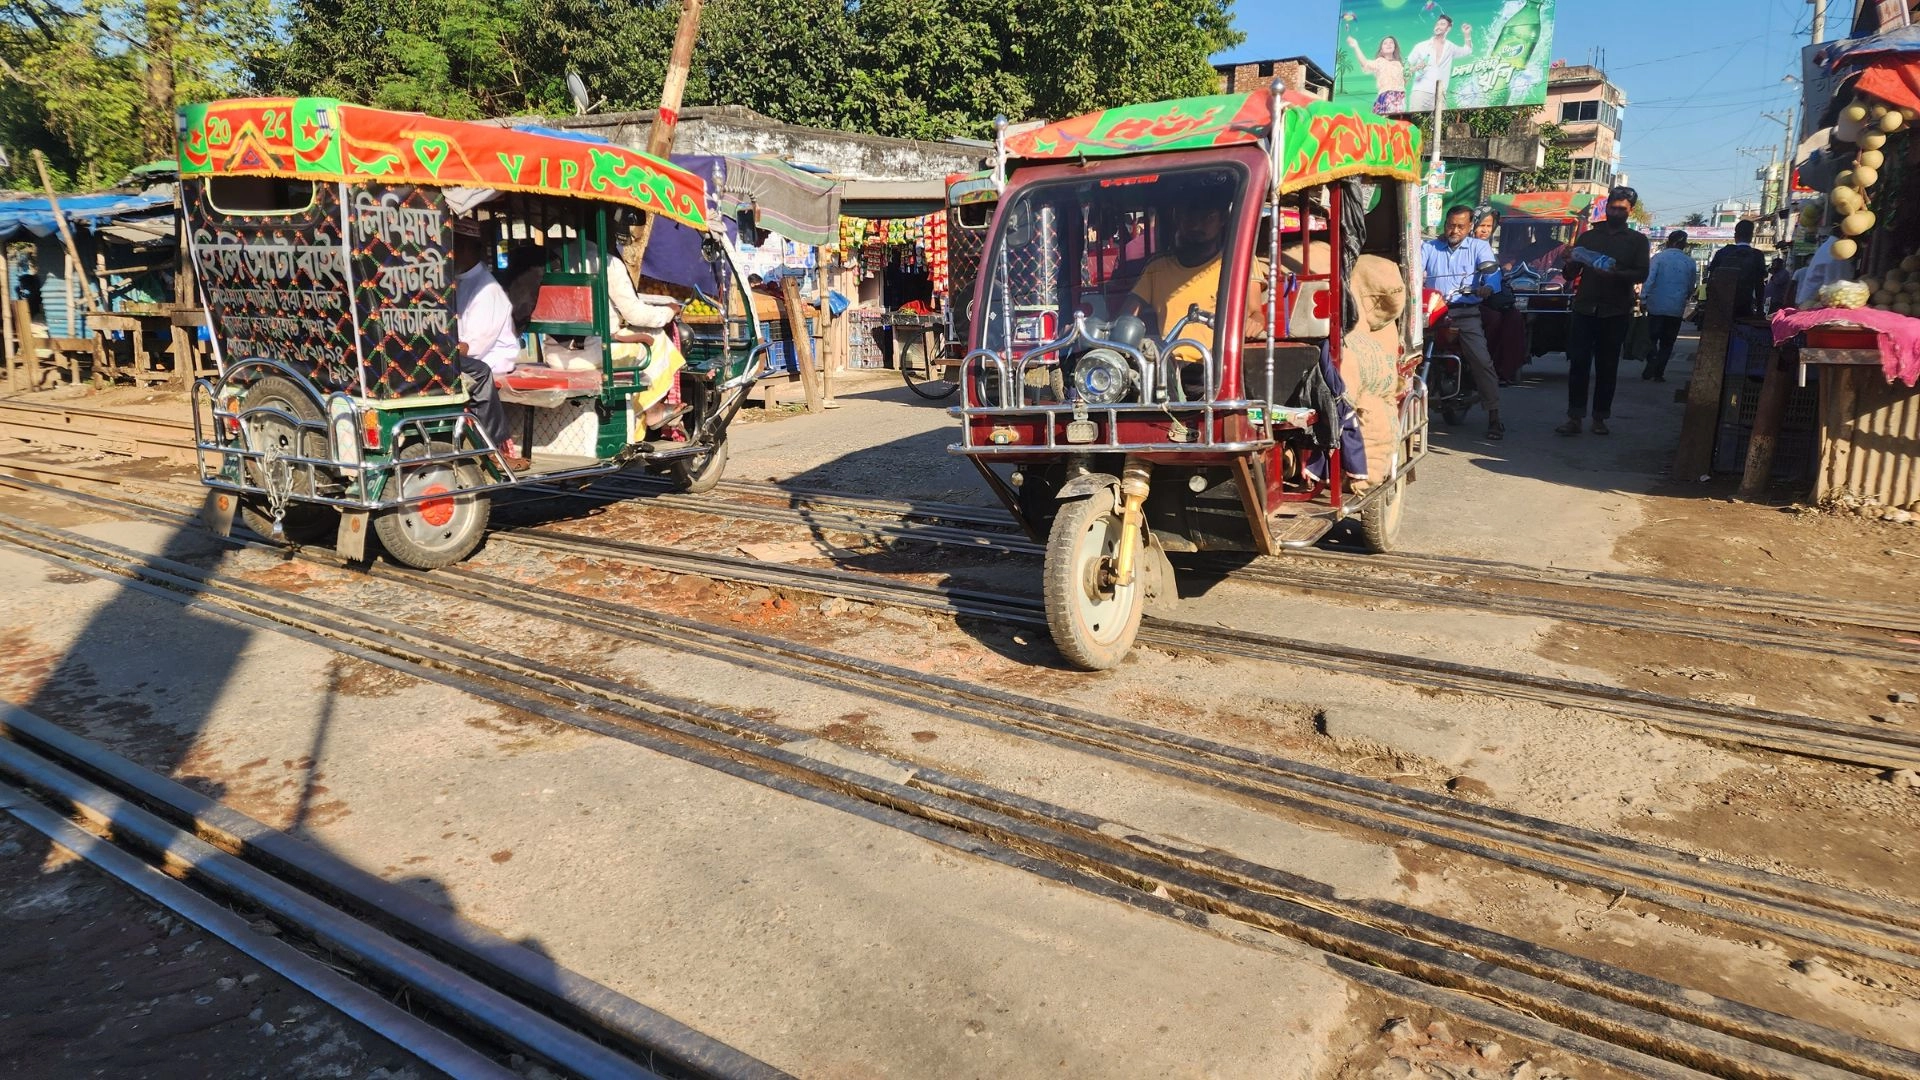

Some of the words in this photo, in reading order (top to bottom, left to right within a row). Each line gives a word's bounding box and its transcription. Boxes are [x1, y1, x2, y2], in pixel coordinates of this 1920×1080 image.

[208, 116, 231, 145] 20
[262, 109, 286, 139] 26
[496, 151, 578, 190] VIP
[243, 231, 295, 279] অটো
